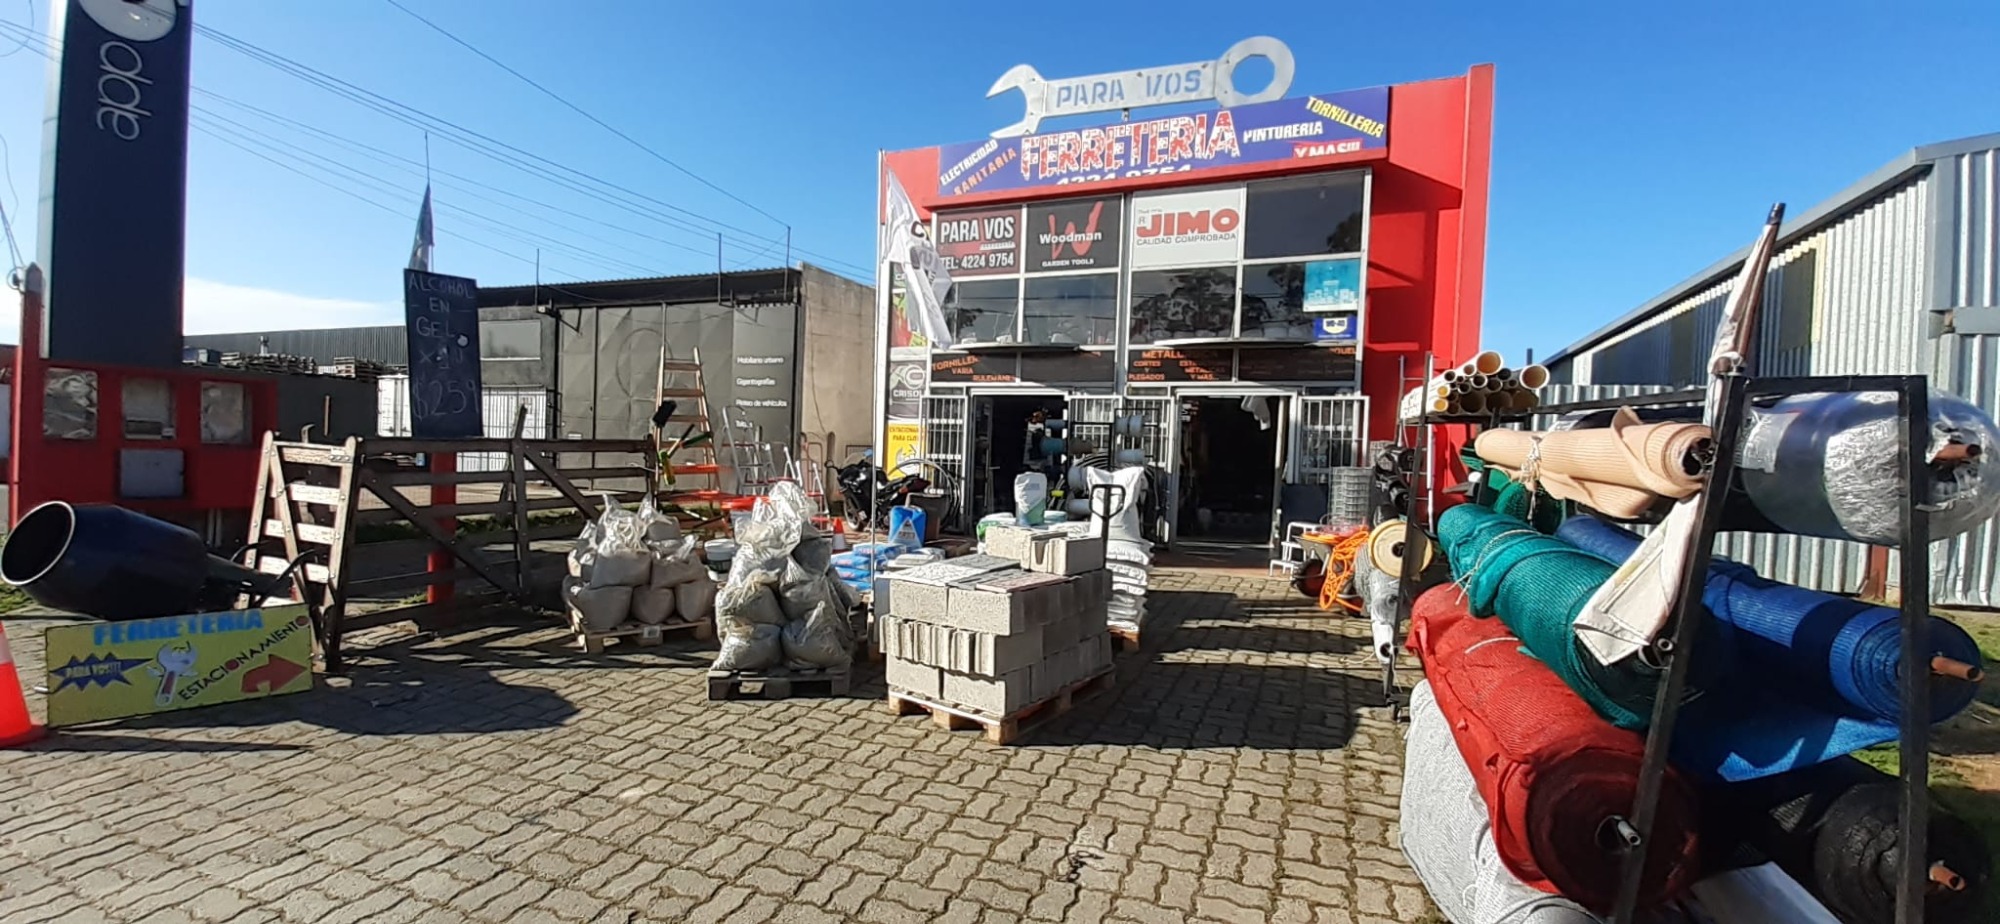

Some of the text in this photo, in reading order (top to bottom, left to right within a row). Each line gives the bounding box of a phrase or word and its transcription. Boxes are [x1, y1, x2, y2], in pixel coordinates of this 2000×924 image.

[1056, 70, 1200, 108] PARA VOS
[1306, 95, 1385, 139] TORNILLERIA
[1020, 110, 1240, 180] FERRETERIA
[1243, 121, 1323, 143] PINTURERIA
[940, 139, 999, 186] ELECTRICIDAD
[953, 147, 1017, 195] SANITARIA
[940, 216, 1015, 243] PARA VOS
[1136, 208, 1240, 237] JIMO
[1039, 230, 1102, 244] Woodman
[1136, 233, 1237, 246] CALIDAD COMPROBADA
[961, 254, 986, 269] 4224
[989, 252, 1014, 268] 9754
[1042, 258, 1094, 267] GARDEN TOOLS
[408, 273, 475, 299] ALCOHOL
[429, 296, 451, 313] EN
[416, 315, 455, 338] GEL
[94, 609, 264, 646] FERRETERIA
[178, 615, 309, 701] ESTACIONAMIENTO
